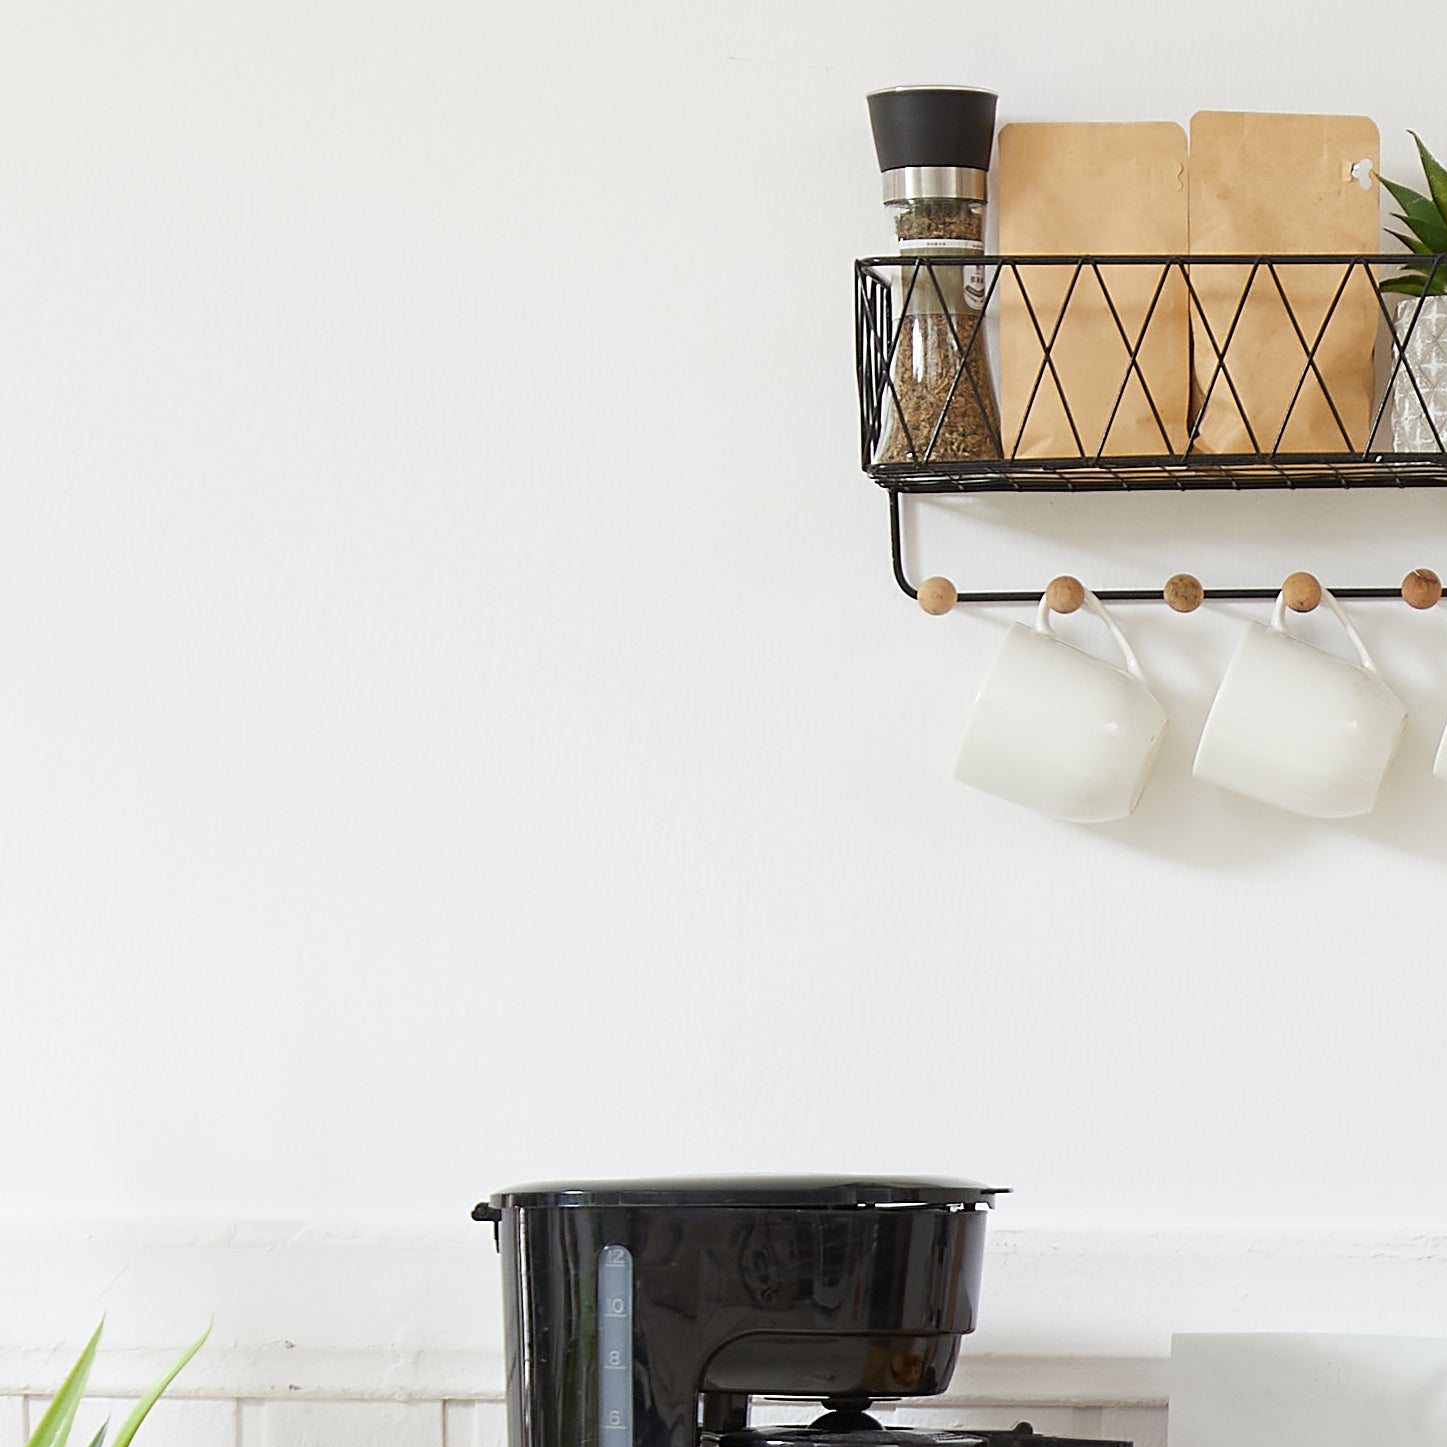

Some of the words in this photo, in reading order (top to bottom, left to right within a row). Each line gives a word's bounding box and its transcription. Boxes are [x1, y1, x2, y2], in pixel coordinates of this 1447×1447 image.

[608, 1298, 624, 1314] 10
[609, 1350, 621, 1365] 8
[609, 1410, 621, 1425] 6
